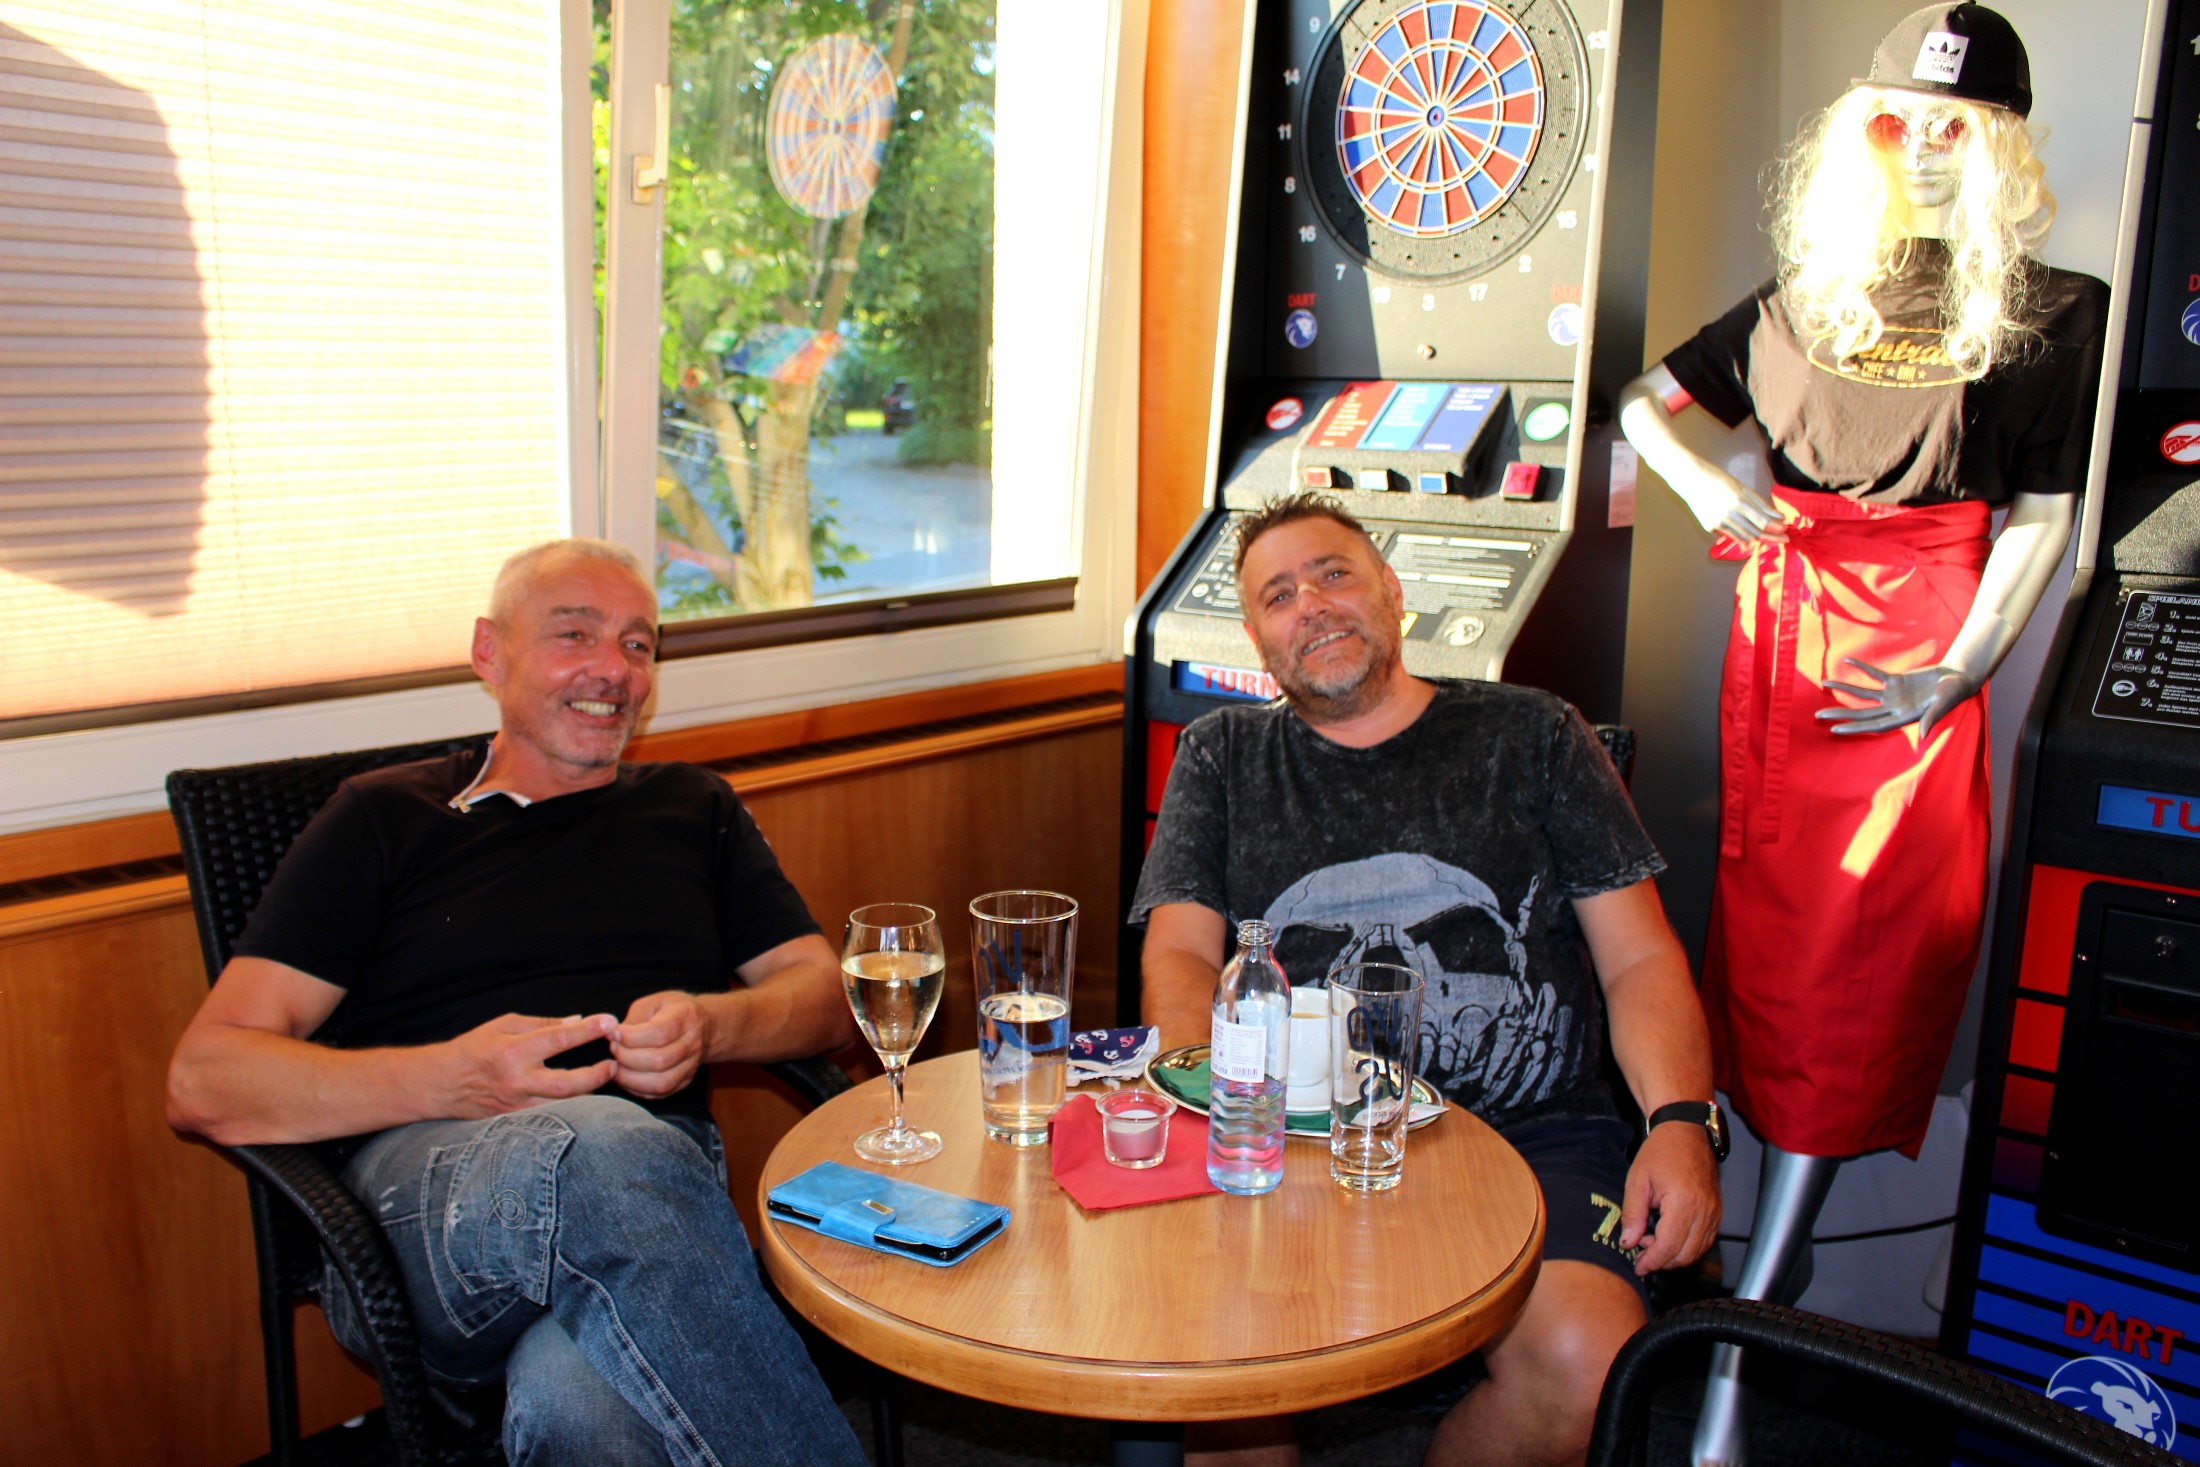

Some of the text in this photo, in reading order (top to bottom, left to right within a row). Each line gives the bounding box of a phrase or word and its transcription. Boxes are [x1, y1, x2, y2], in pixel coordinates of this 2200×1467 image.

[1308, 16, 1320, 34] 9
[1283, 67, 1300, 86] 14
[1920, 63, 1955, 75] didas
[1277, 123, 1292, 141] 11
[1284, 176, 1296, 194] 8
[1556, 209, 1578, 230] 15
[1299, 225, 1317, 243] 16
[1335, 263, 1347, 281] 7
[1518, 254, 1532, 273] 2
[1287, 292, 1317, 308] DART
[1468, 283, 1489, 302] 17
[1861, 360, 1886, 379] CAFE
[1200, 666, 1278, 700] TURN
[2145, 796, 2200, 833] TU
[1590, 1192, 1622, 1238] 7
[2063, 1298, 2184, 1366] DART
